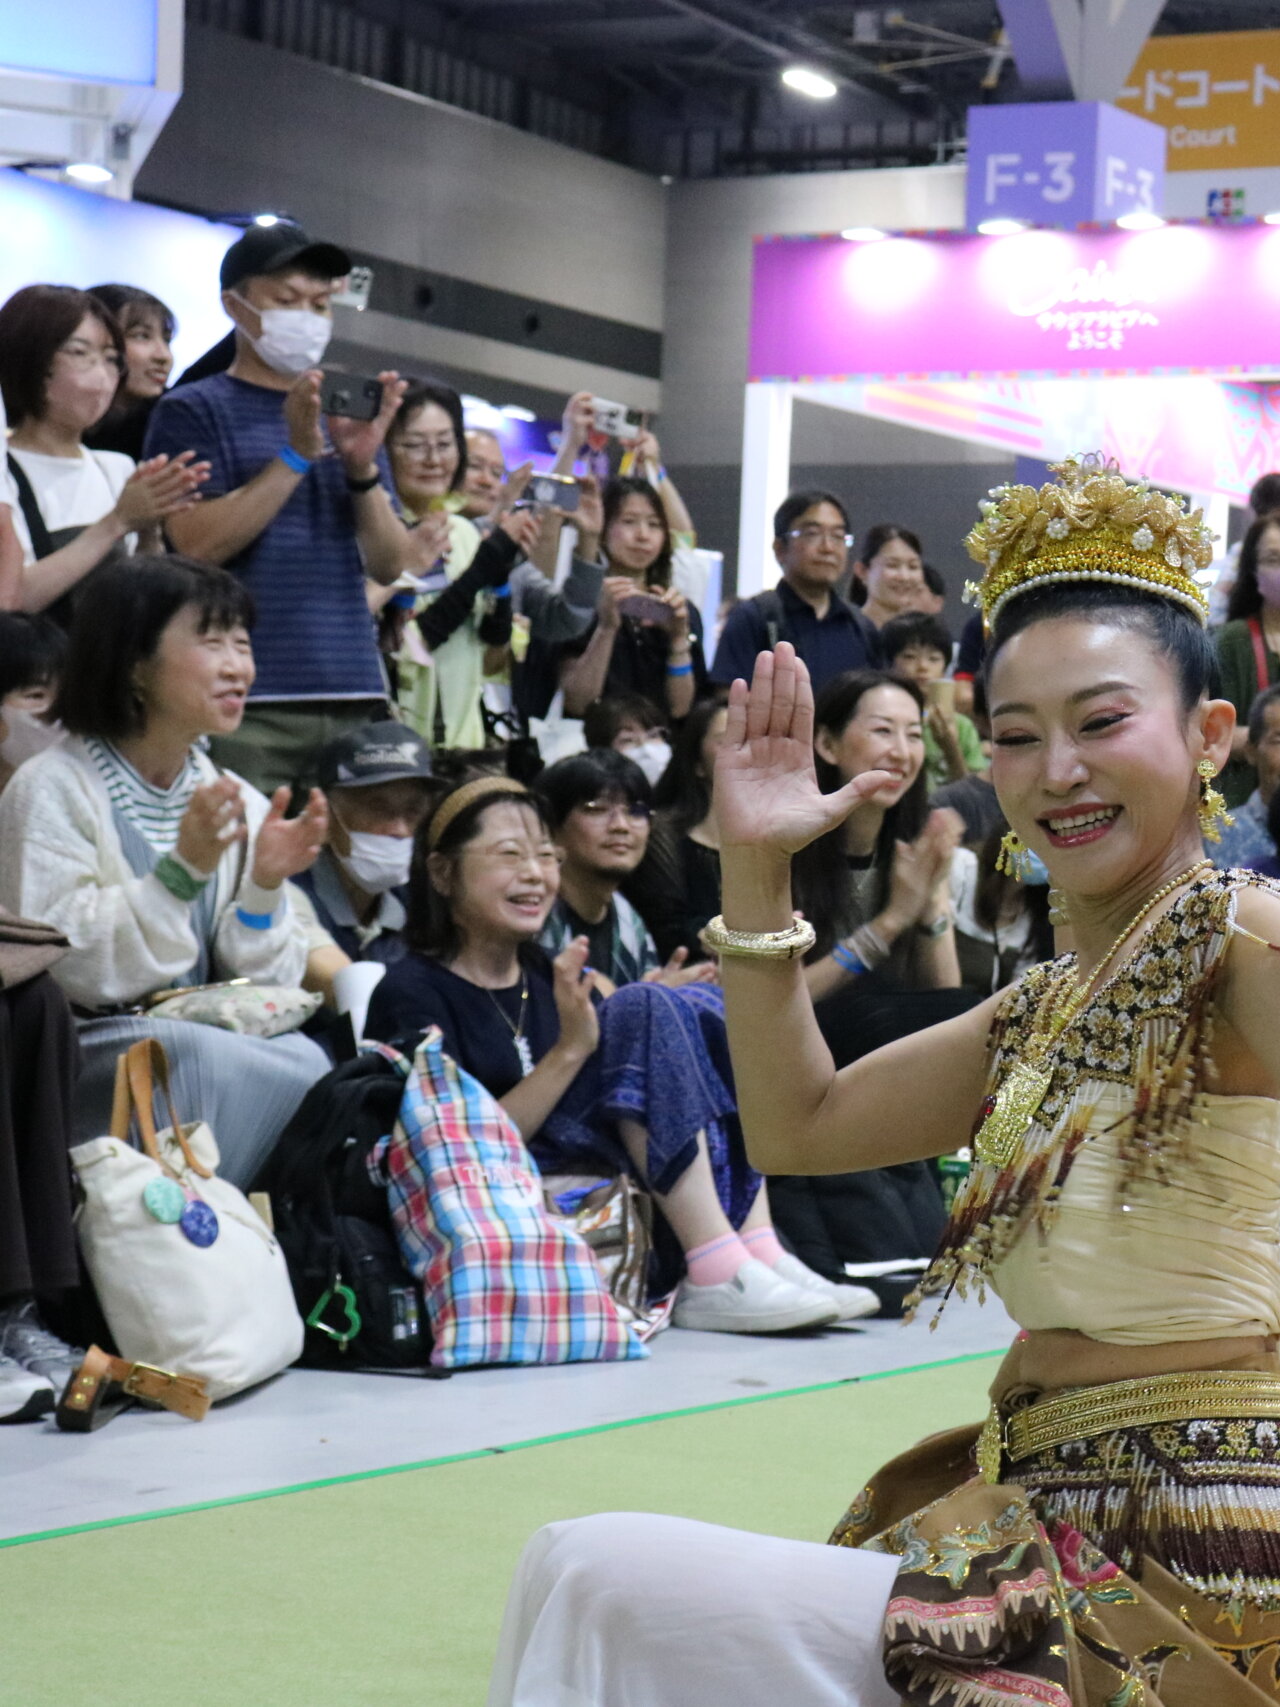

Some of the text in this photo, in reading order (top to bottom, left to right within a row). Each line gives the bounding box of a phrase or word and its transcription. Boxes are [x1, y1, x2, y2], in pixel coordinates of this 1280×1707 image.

[1170, 126, 1237, 148] Court
[986, 152, 1075, 203] F-3
[1105, 155, 1154, 212] F-3
[1068, 330, 1125, 350] ようこそ
